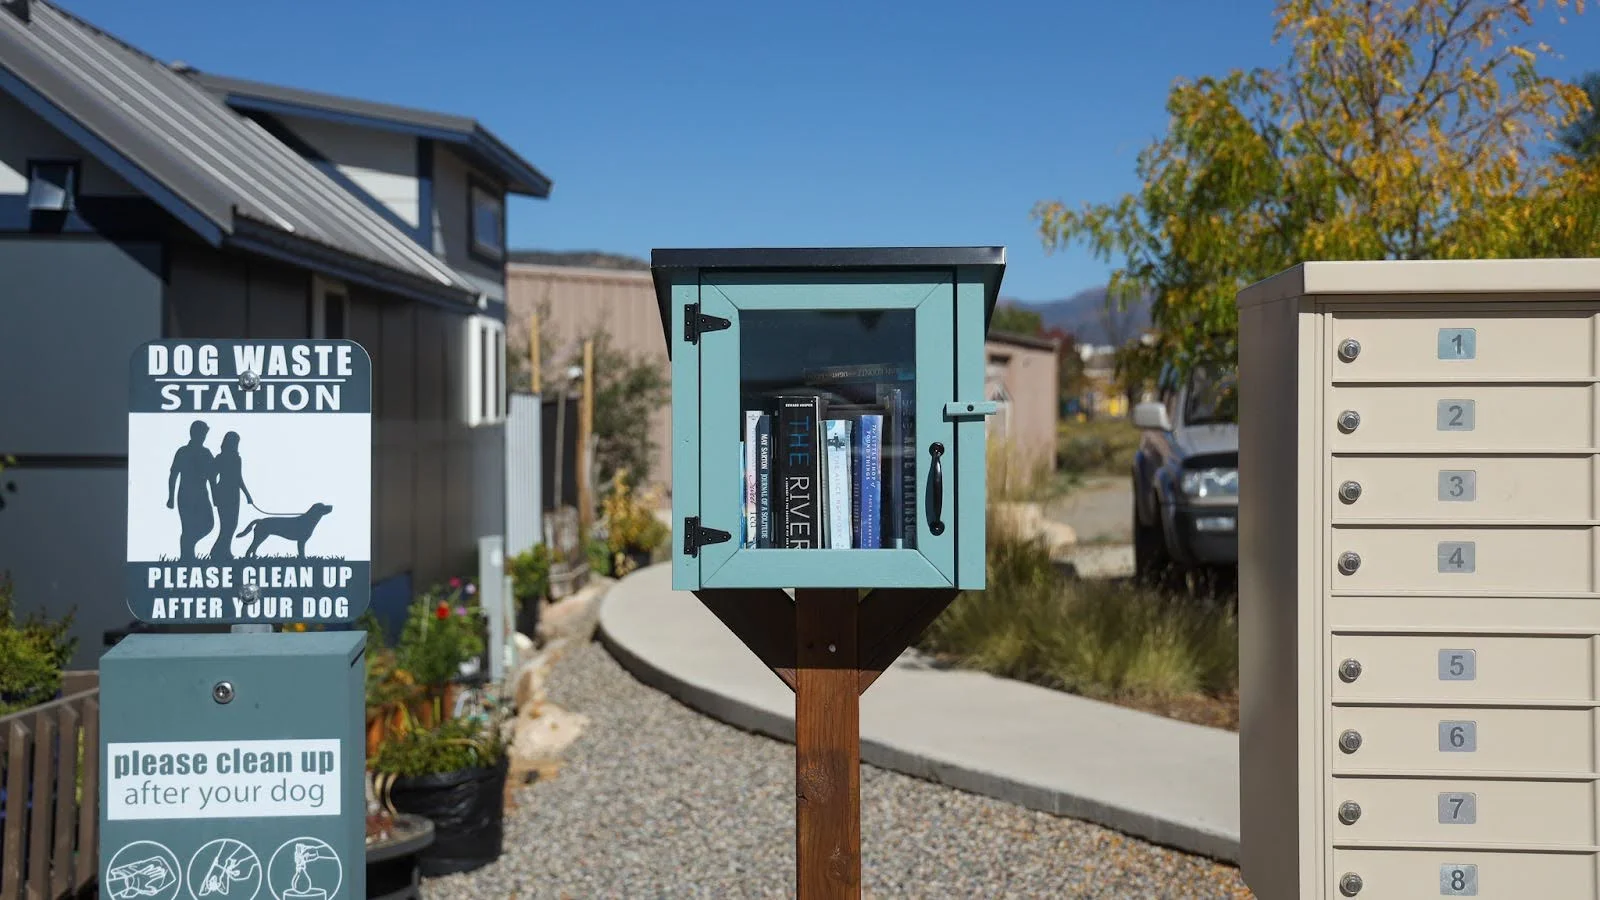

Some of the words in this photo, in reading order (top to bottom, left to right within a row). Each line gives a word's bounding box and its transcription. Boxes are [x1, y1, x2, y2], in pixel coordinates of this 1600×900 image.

[1451, 333, 1462, 355] 1
[148, 344, 218, 376] DOG
[233, 345, 352, 376] WASTE
[161, 384, 341, 411] STATION
[1448, 405, 1463, 427] 2
[789, 415, 810, 466] THE
[760, 474, 769, 497] JOURNAL
[1449, 475, 1463, 497] 3
[789, 476, 811, 549] RIVER
[761, 511, 769, 539] SOLITUDE
[1448, 547, 1465, 569] 4
[148, 567, 233, 589] PLEASE
[242, 566, 313, 588] CLEAN
[323, 566, 353, 588] UP
[152, 597, 223, 619] AFTER
[232, 596, 293, 619] YOUR
[302, 596, 349, 619] DOG
[1449, 655, 1464, 676] 5
[1449, 726, 1465, 748] 6
[114, 750, 208, 779] please
[216, 748, 293, 774] clean
[301, 750, 334, 775] up
[124, 780, 190, 805] after
[199, 784, 261, 810] your
[270, 778, 324, 808] dog
[1449, 798, 1464, 819] 7
[1450, 869, 1466, 891] 8
